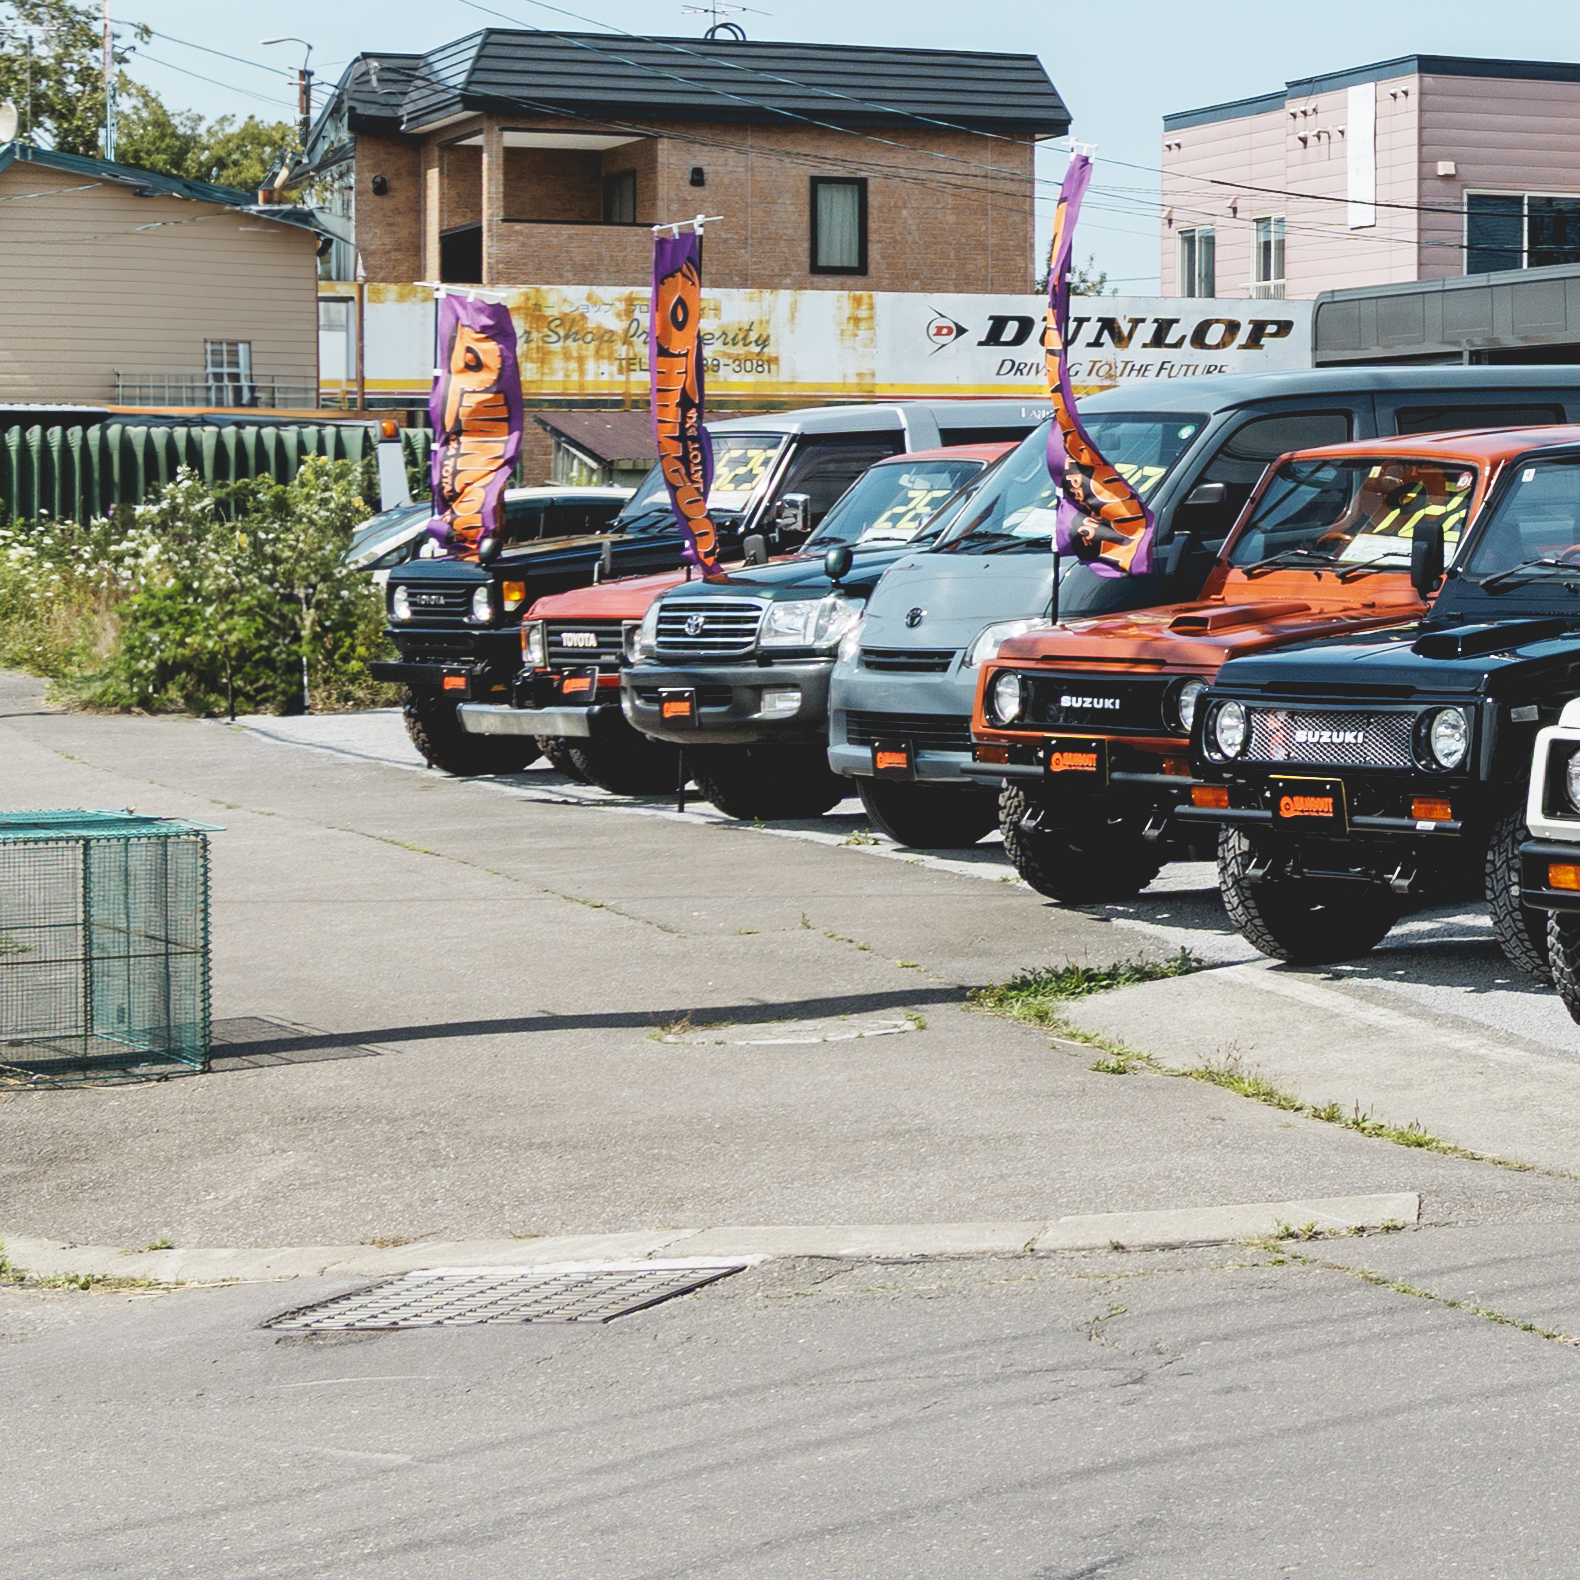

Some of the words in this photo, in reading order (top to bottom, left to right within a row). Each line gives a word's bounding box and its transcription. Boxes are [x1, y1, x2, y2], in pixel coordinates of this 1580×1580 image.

[542, 318, 615, 349] Shop
[1117, 360, 1154, 377] THE
[416, 595, 445, 606] TOYOTA
[561, 632, 597, 647] TOYOTA
[1060, 695, 1120, 709] SUZUKI
[1295, 730, 1364, 744] SUZUKI
